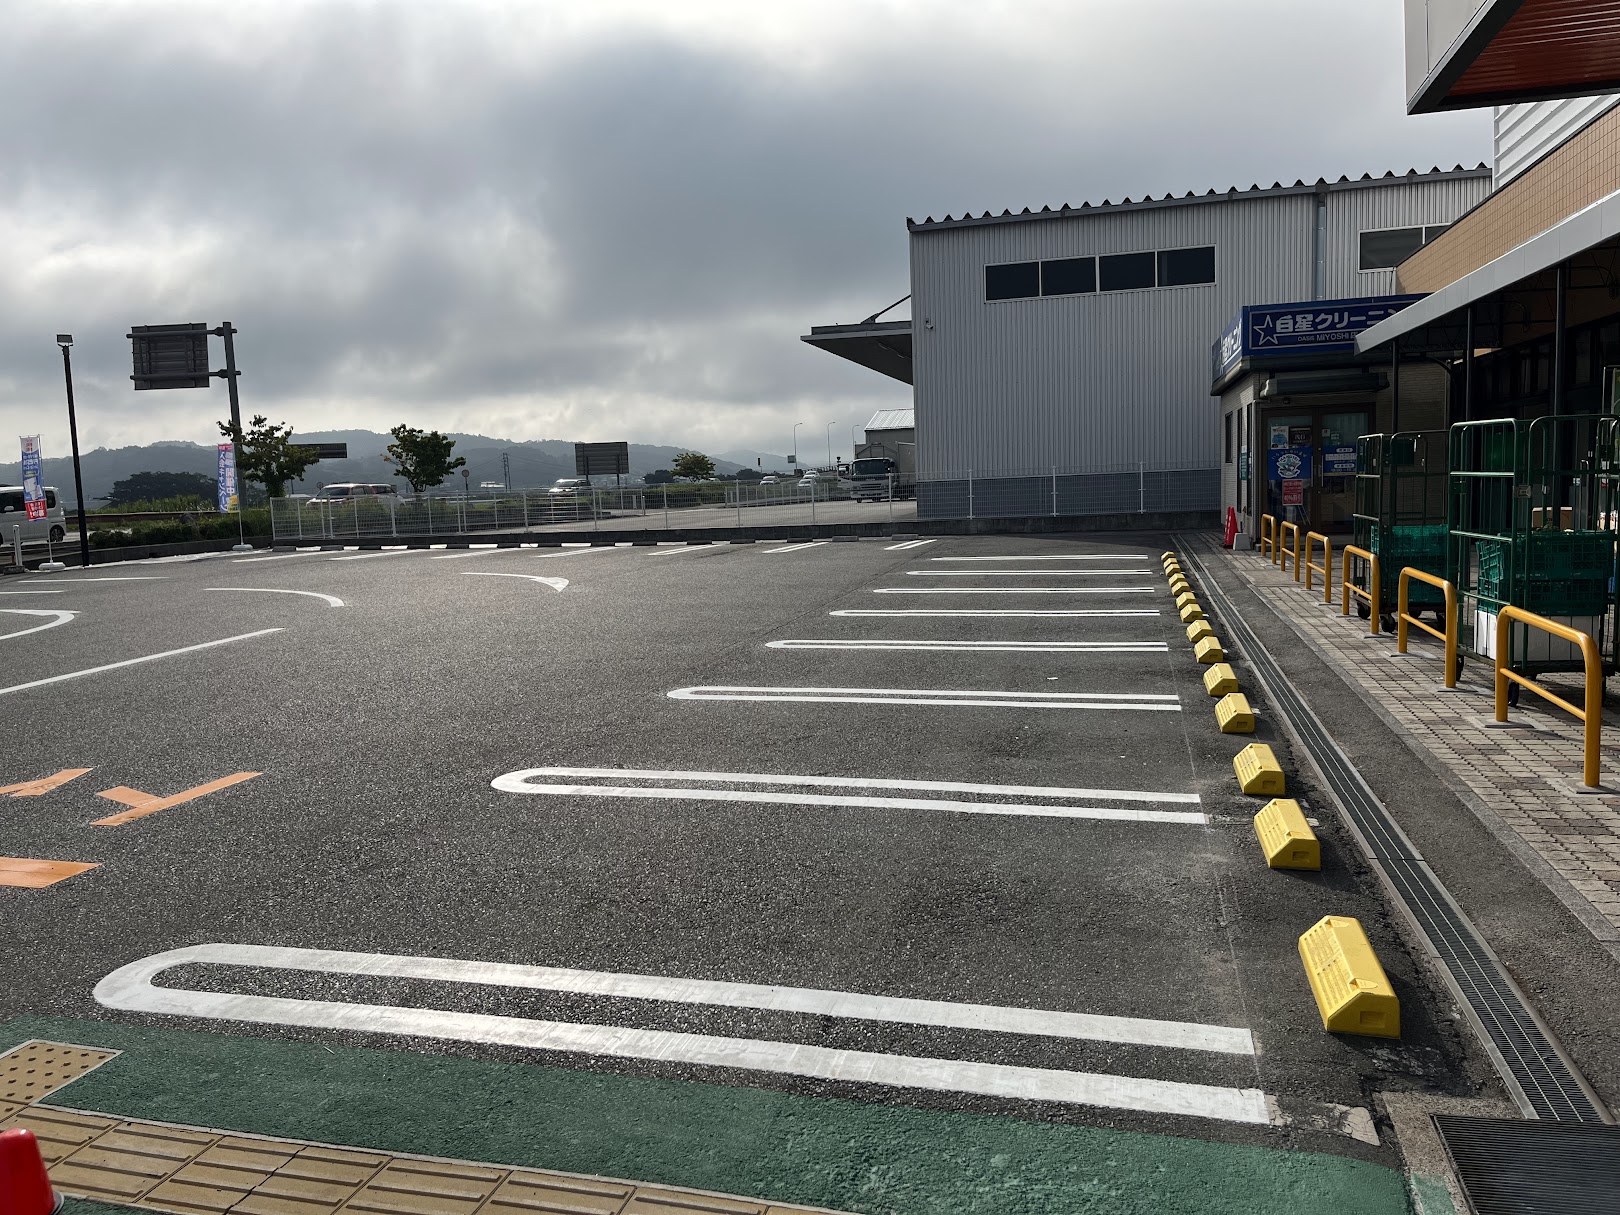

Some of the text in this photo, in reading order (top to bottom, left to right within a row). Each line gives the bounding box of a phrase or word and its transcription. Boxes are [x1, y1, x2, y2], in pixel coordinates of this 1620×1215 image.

[1275, 308, 1397, 333] 白星クリーニ
